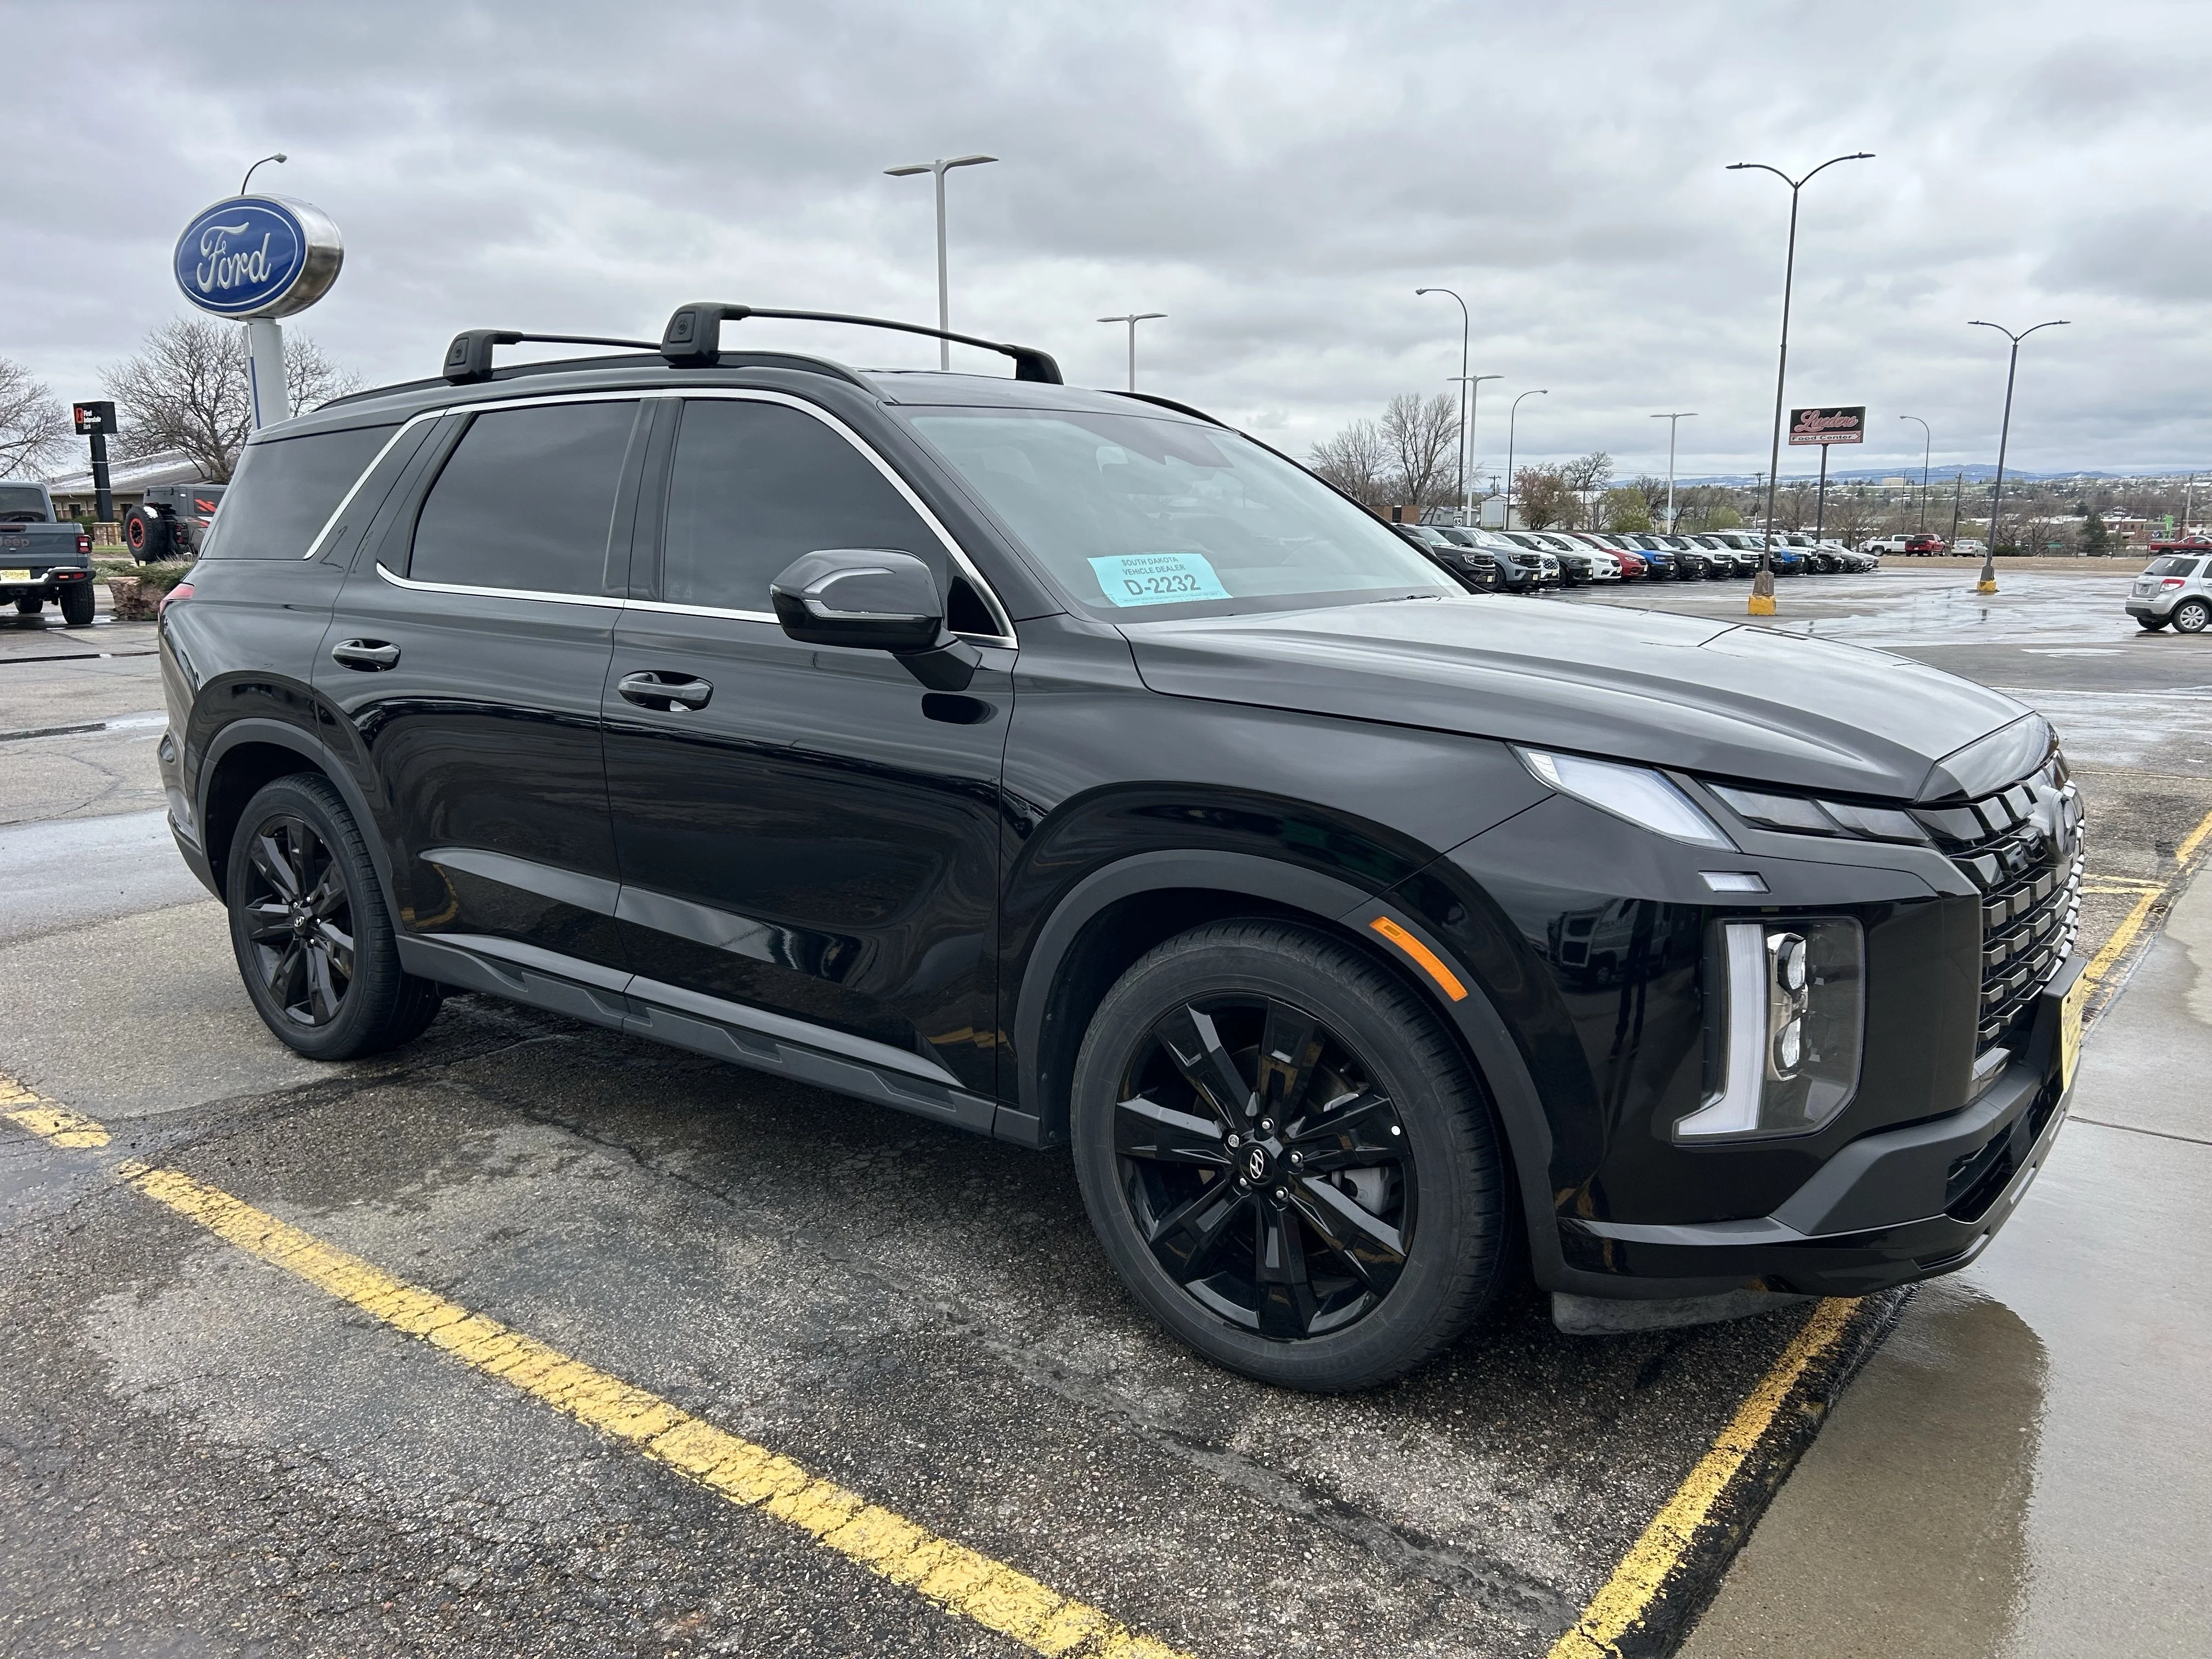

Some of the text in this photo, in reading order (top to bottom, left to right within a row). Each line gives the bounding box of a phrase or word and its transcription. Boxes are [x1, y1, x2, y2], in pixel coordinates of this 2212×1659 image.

[196, 222, 272, 294] Ford
[1794, 410, 1859, 432] Lueders
[1122, 565, 1186, 575] VEHICLE DEALER
[1148, 557, 1178, 565] DAKOTA
[1123, 574, 1201, 595] D-2232
